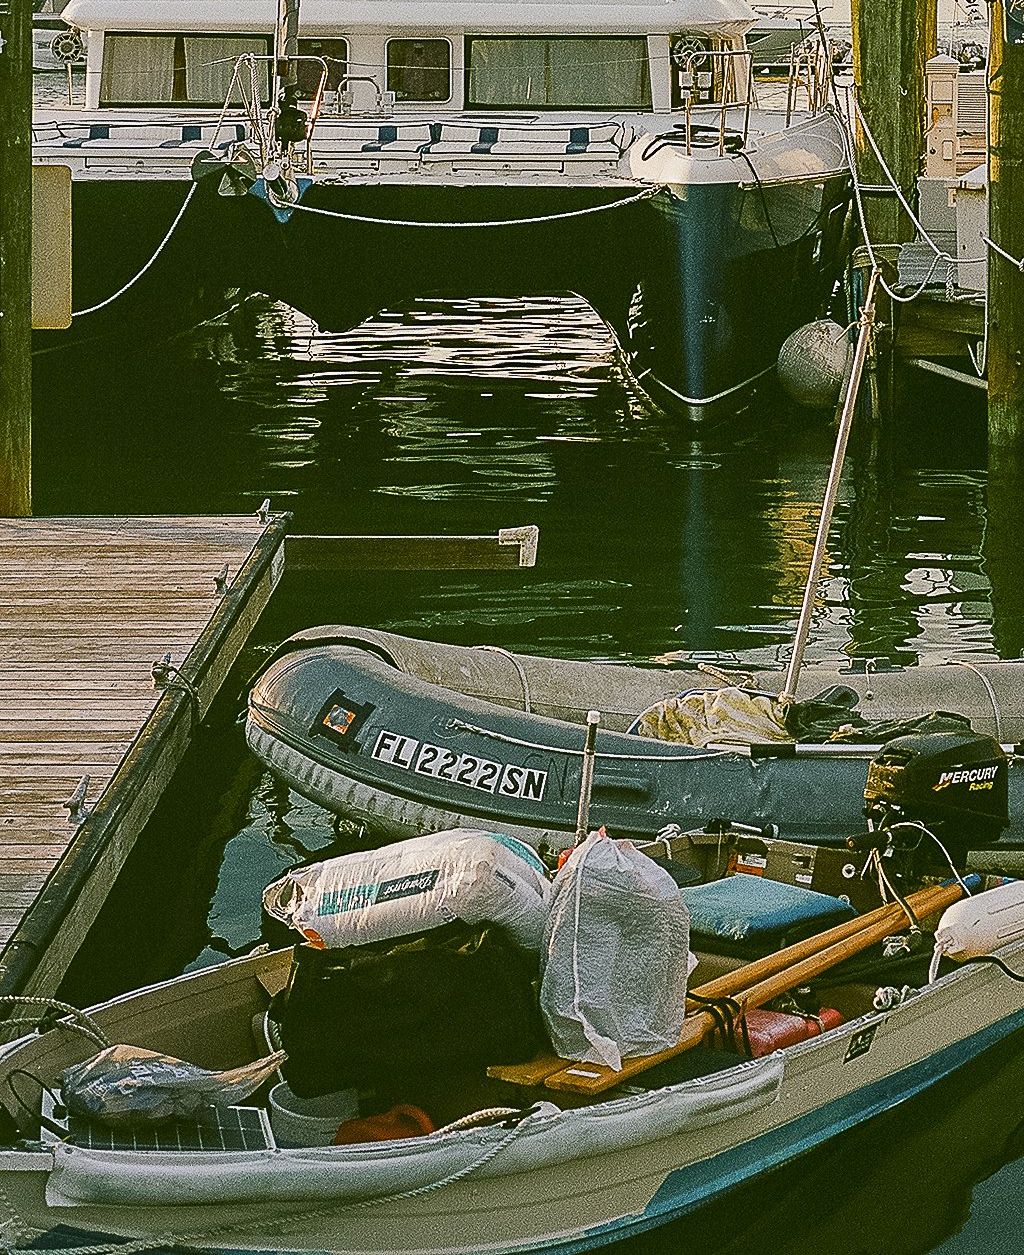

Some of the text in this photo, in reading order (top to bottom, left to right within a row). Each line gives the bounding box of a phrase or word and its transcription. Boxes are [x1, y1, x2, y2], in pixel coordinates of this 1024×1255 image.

[373, 732, 409, 766] FL
[418, 747, 499, 791] 2222
[502, 767, 546, 799] SN
[938, 765, 999, 785] MERCURY
[968, 781, 994, 791] Racing
